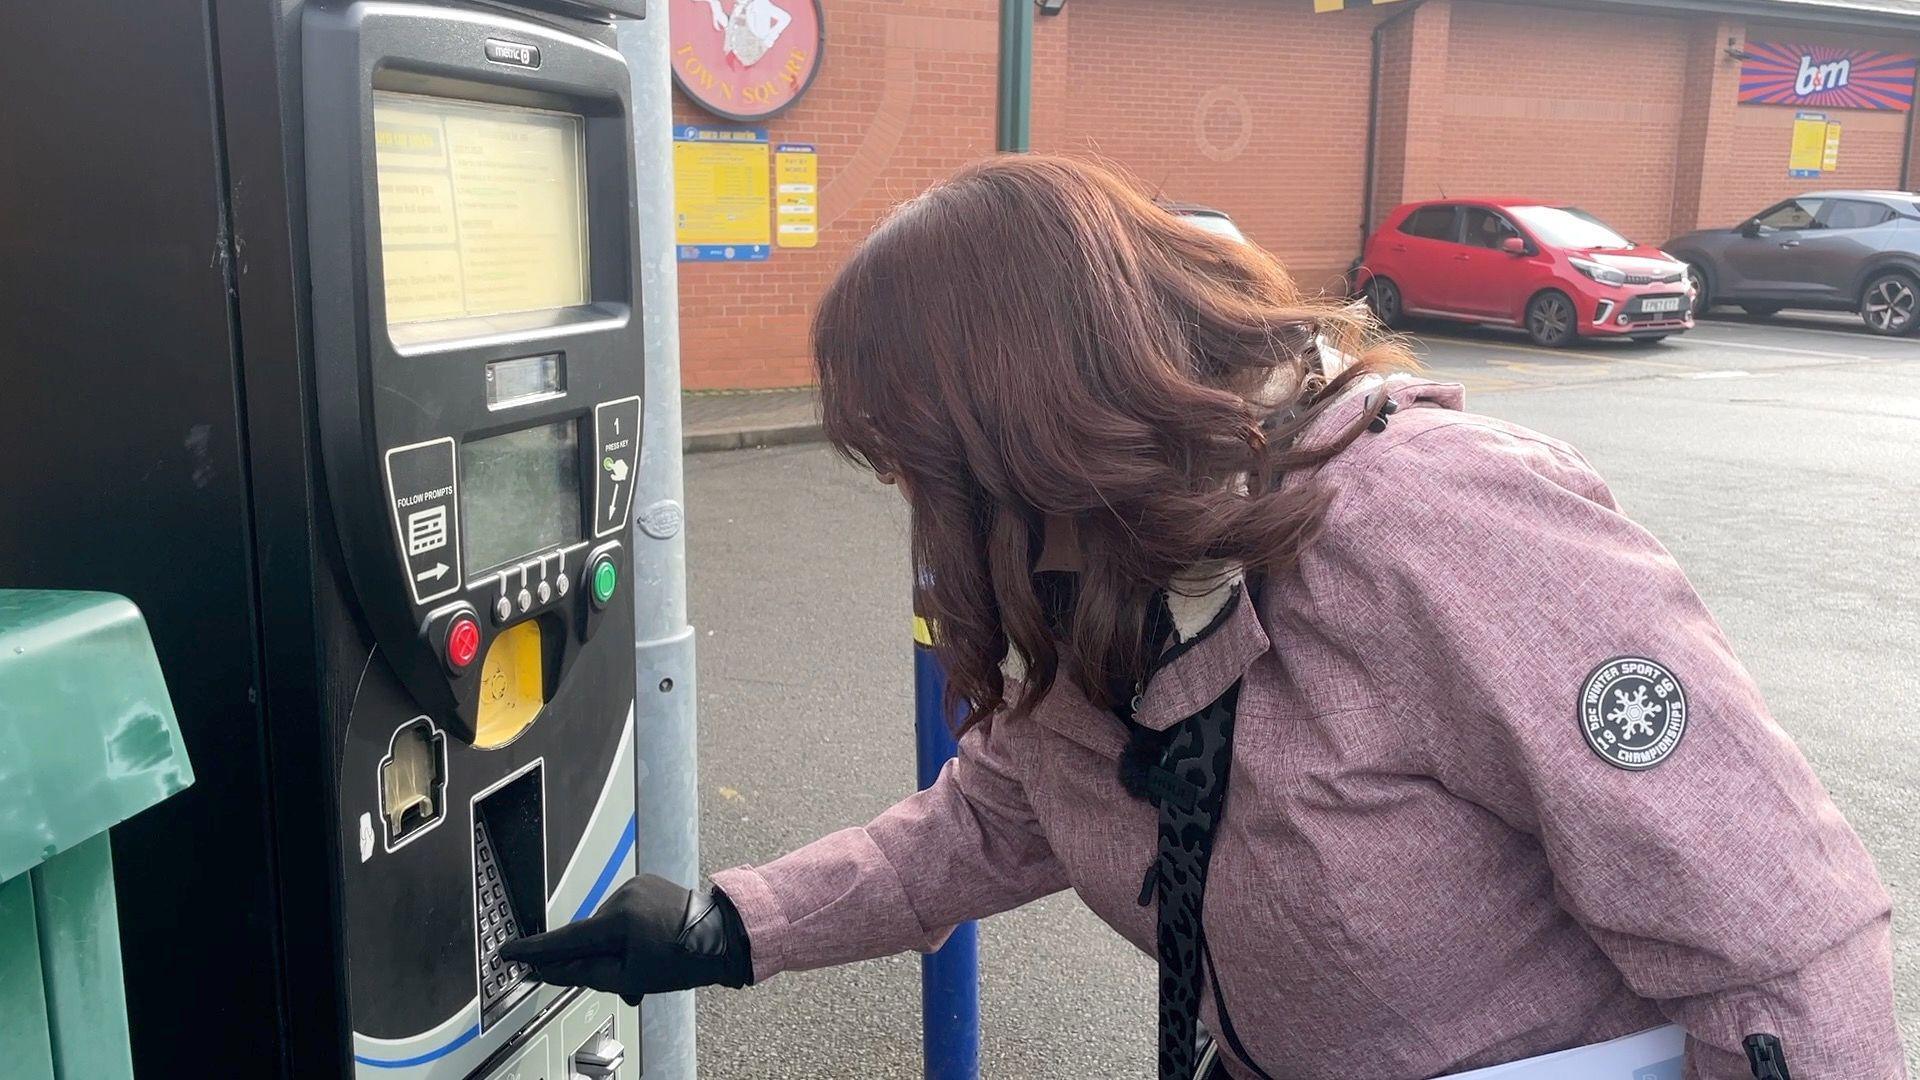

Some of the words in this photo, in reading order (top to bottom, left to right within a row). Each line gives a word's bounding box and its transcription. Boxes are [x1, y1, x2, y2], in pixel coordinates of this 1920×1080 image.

[613, 417, 620, 435] 1
[605, 441, 620, 453] PRESS
[619, 439, 629, 448] KEY
[397, 493, 424, 508] FOLLOW
[424, 485, 453, 501] PROMPTS
[1587, 666, 1620, 704] WINTER
[1621, 663, 1662, 680] SPORT
[1596, 729, 1617, 751] 19
[1617, 701, 1683, 763] CHAMPIONSHIPS
